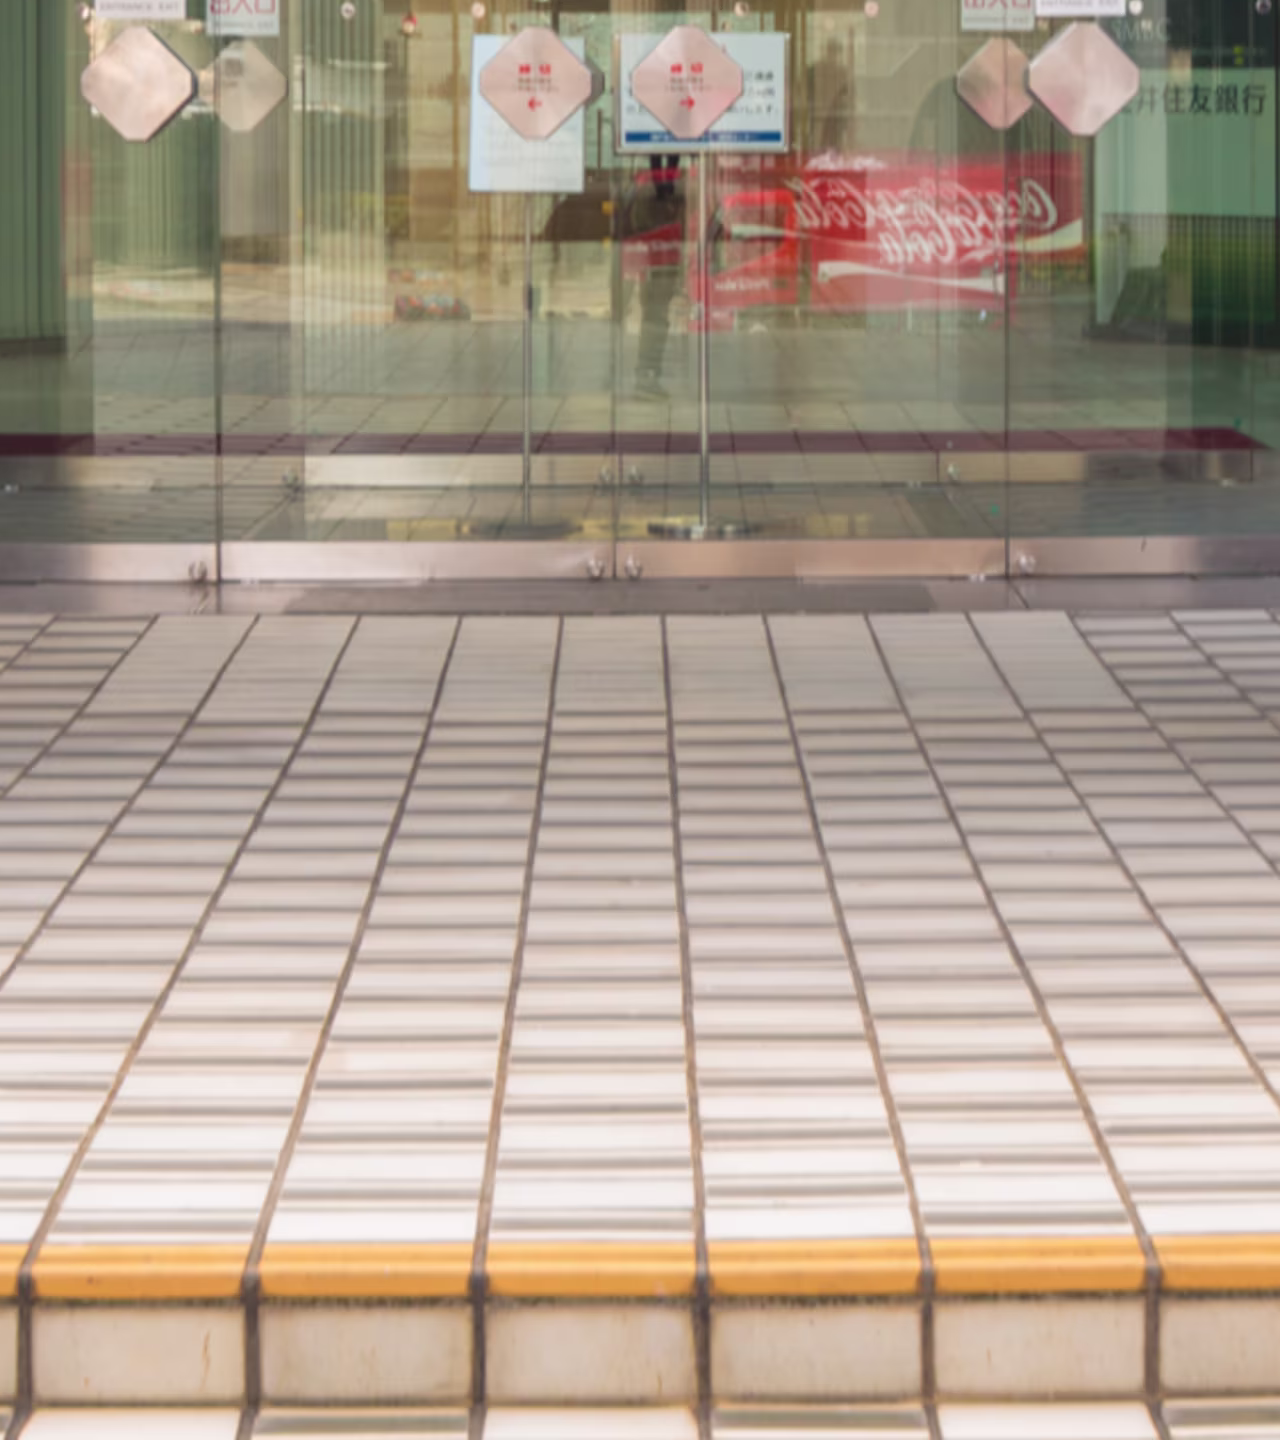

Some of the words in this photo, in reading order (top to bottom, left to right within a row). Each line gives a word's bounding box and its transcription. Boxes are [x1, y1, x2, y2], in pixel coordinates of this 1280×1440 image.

[1120, 82, 1267, 116] 井住友銀行
